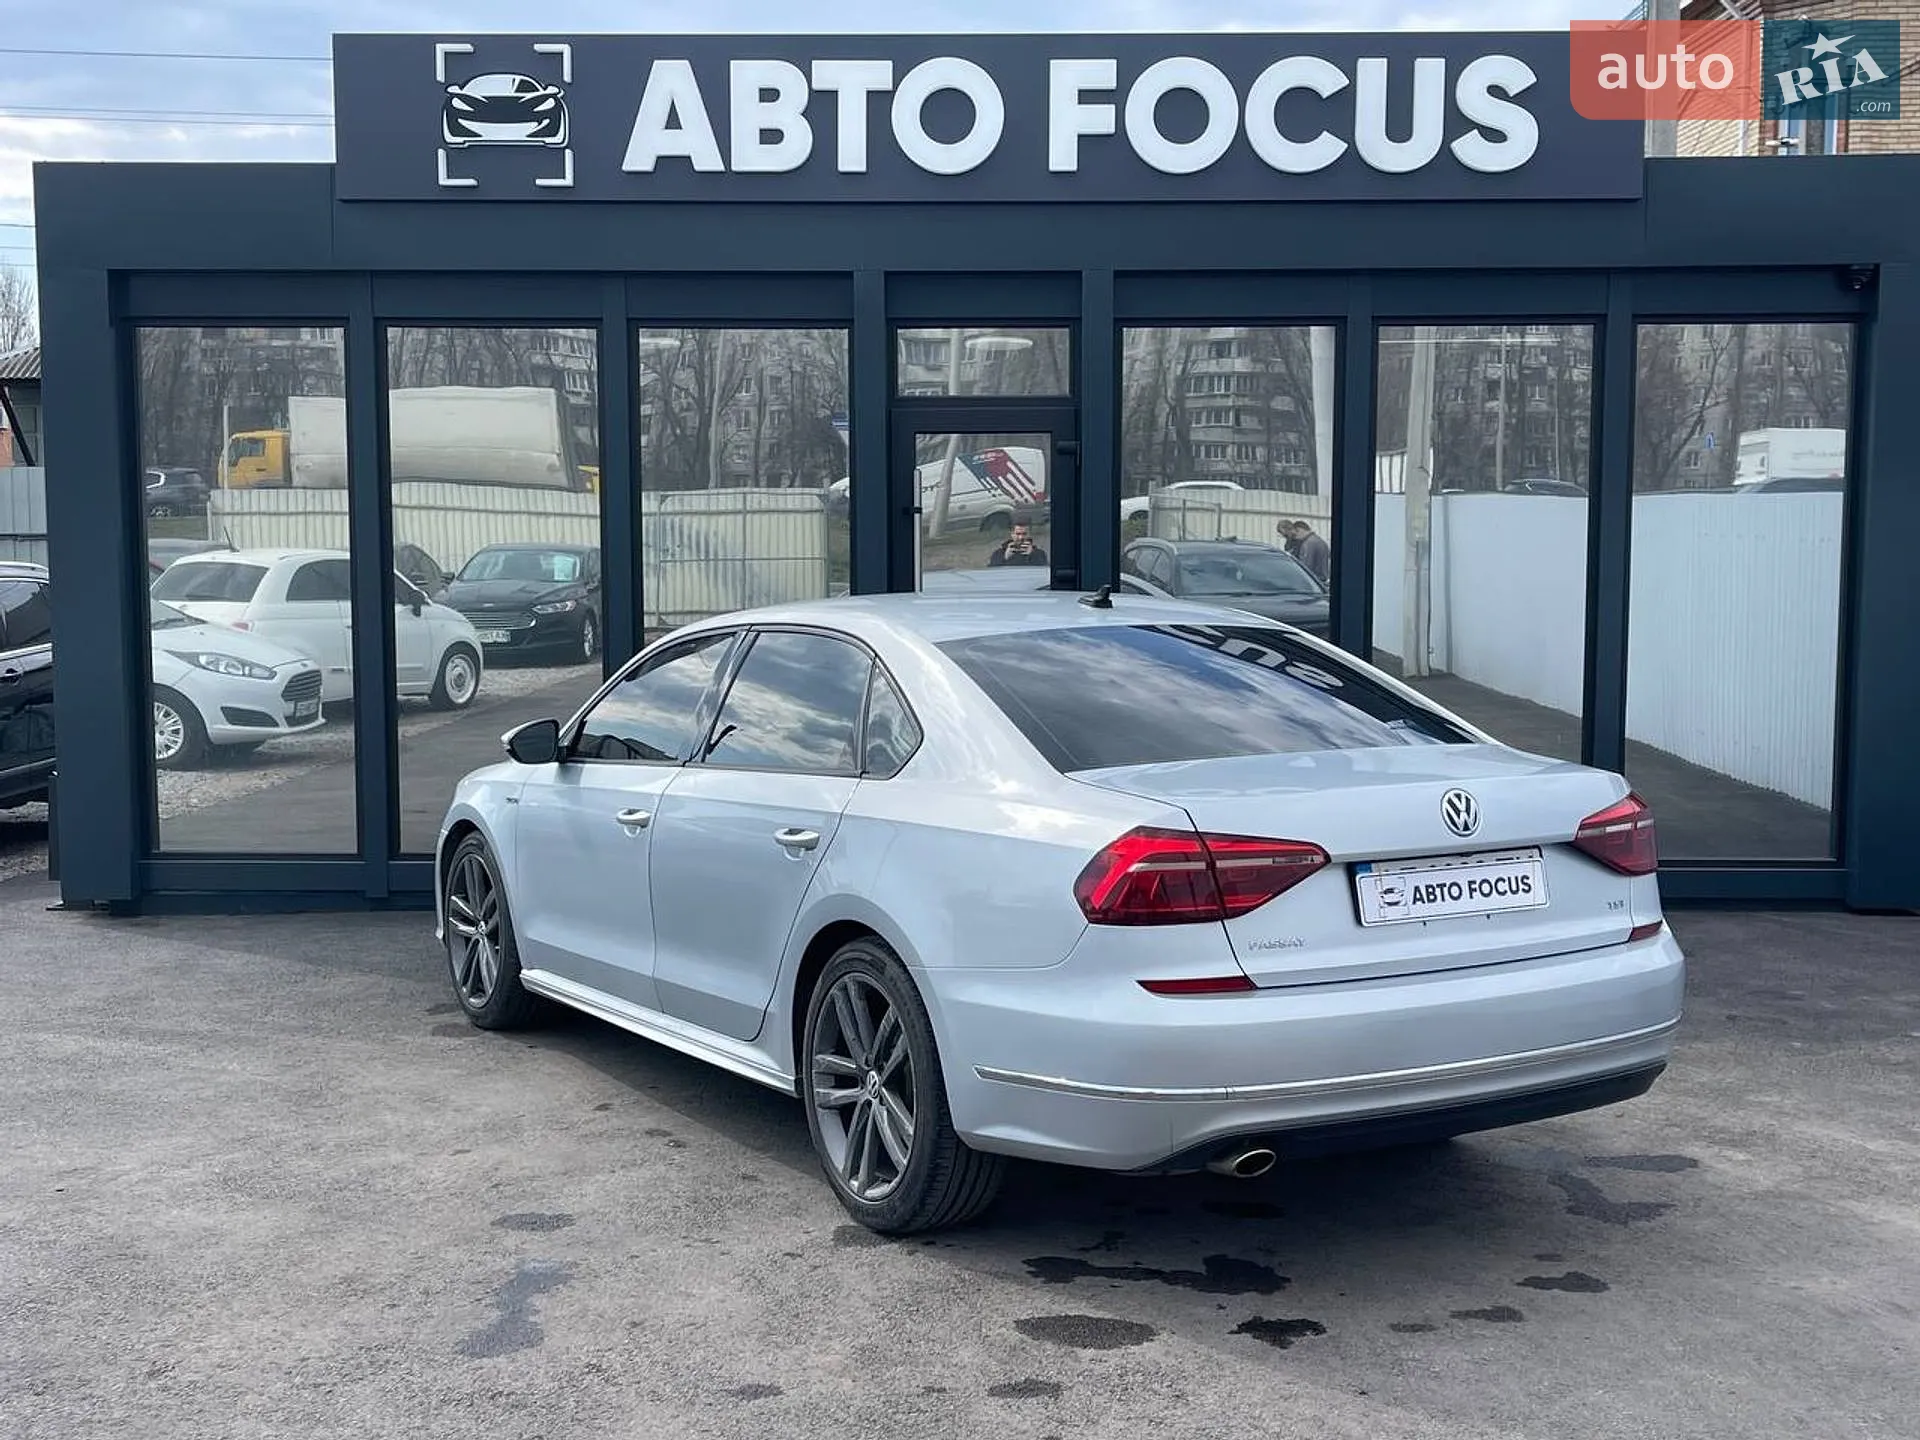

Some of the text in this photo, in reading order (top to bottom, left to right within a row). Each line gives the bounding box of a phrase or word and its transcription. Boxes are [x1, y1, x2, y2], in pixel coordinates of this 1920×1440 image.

[621, 54, 1539, 175] АВТО FOCUS
[1412, 875, 1532, 905] АВТО FOCUS
